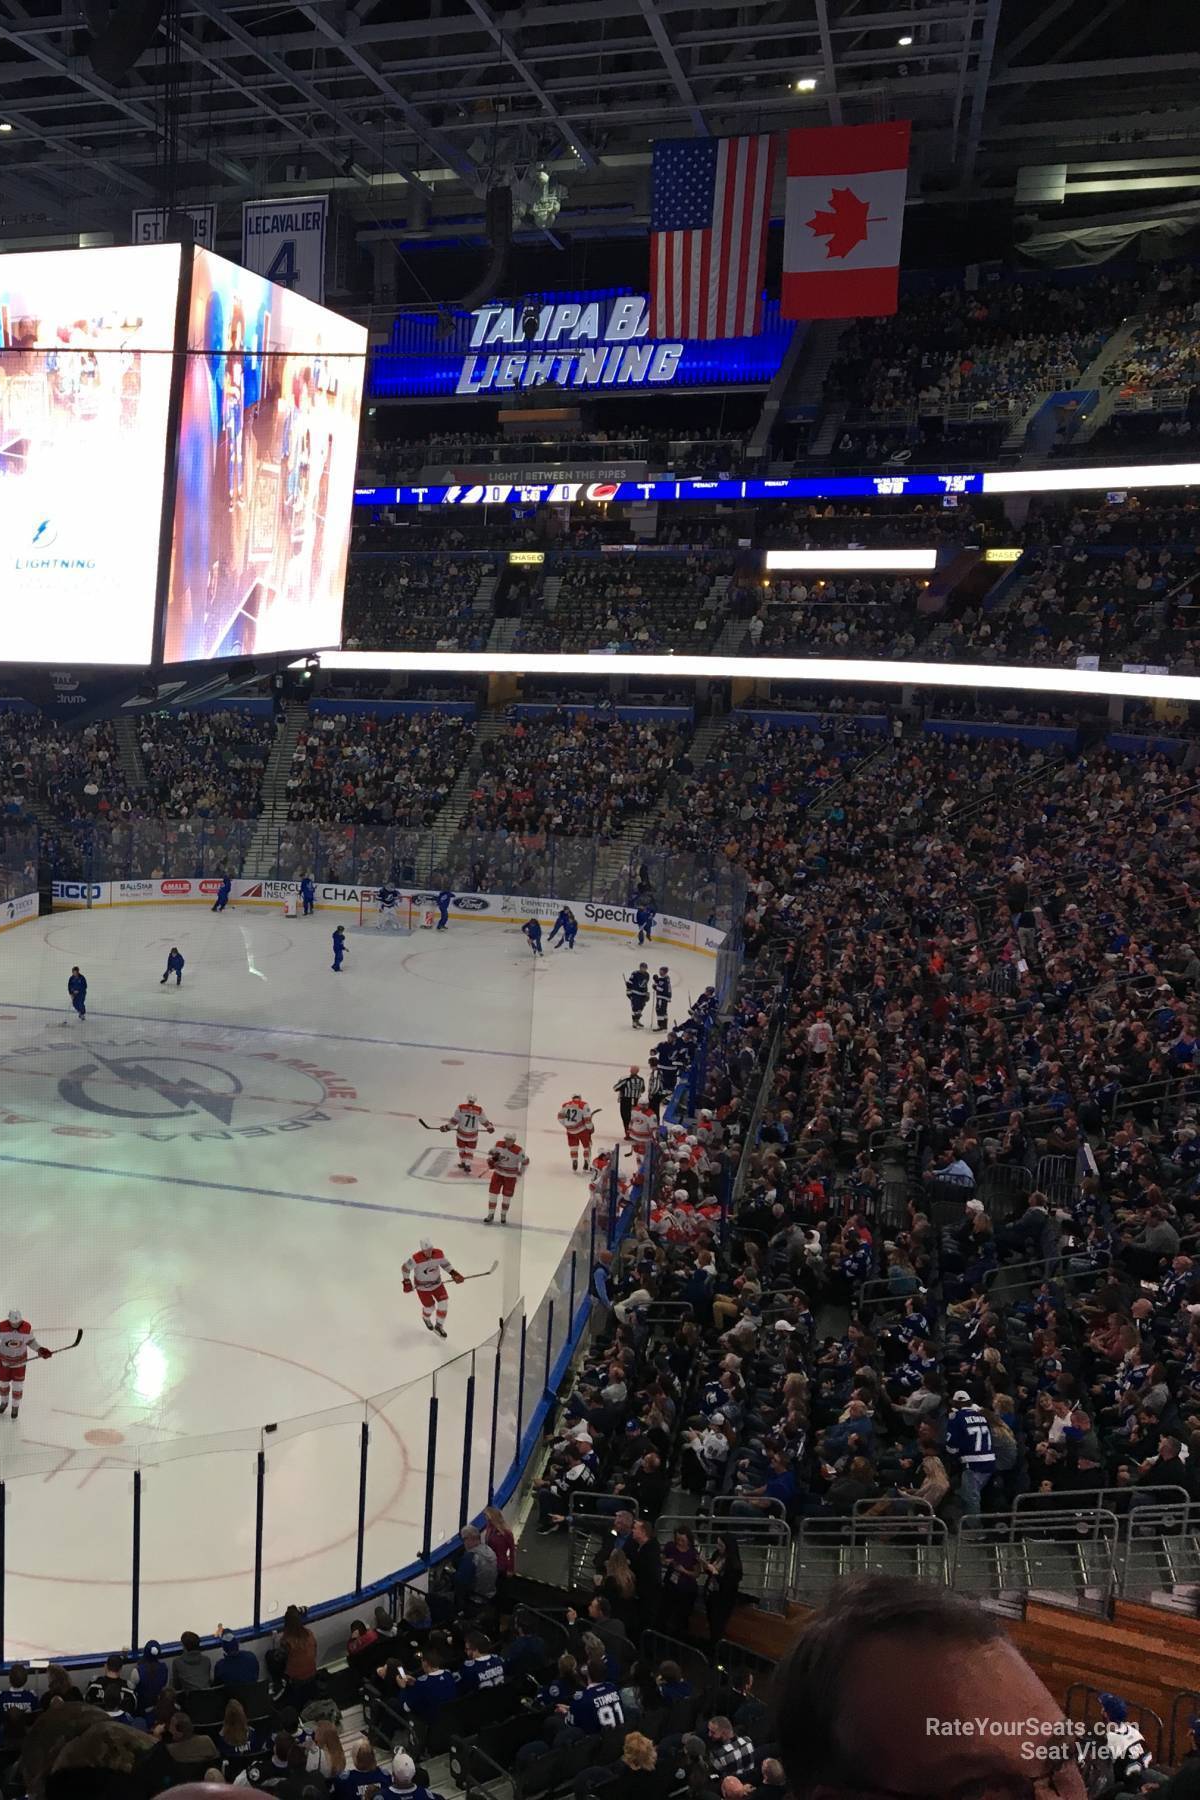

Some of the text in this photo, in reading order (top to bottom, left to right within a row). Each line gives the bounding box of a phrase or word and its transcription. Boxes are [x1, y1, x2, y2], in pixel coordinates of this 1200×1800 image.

[143, 221, 162, 241] ST.
[248, 210, 321, 235] LECAVALIER
[267, 238, 300, 288] 4
[470, 302, 599, 347] TAMPA
[456, 343, 684, 394] LIGHTNING
[488, 469, 627, 482] LIGHT BETWEEN THE PIPES
[15, 558, 96, 569] LIGHTNING
[987, 551, 1013, 559] CHASE
[460, 897, 484, 910] Ford
[585, 903, 639, 924] Spectru
[464, 1114, 476, 1129] 71
[565, 1108, 578, 1123] 42
[966, 1425, 992, 1452] 77
[593, 1690, 620, 1708] STAMKOS
[597, 1702, 625, 1728] 91
